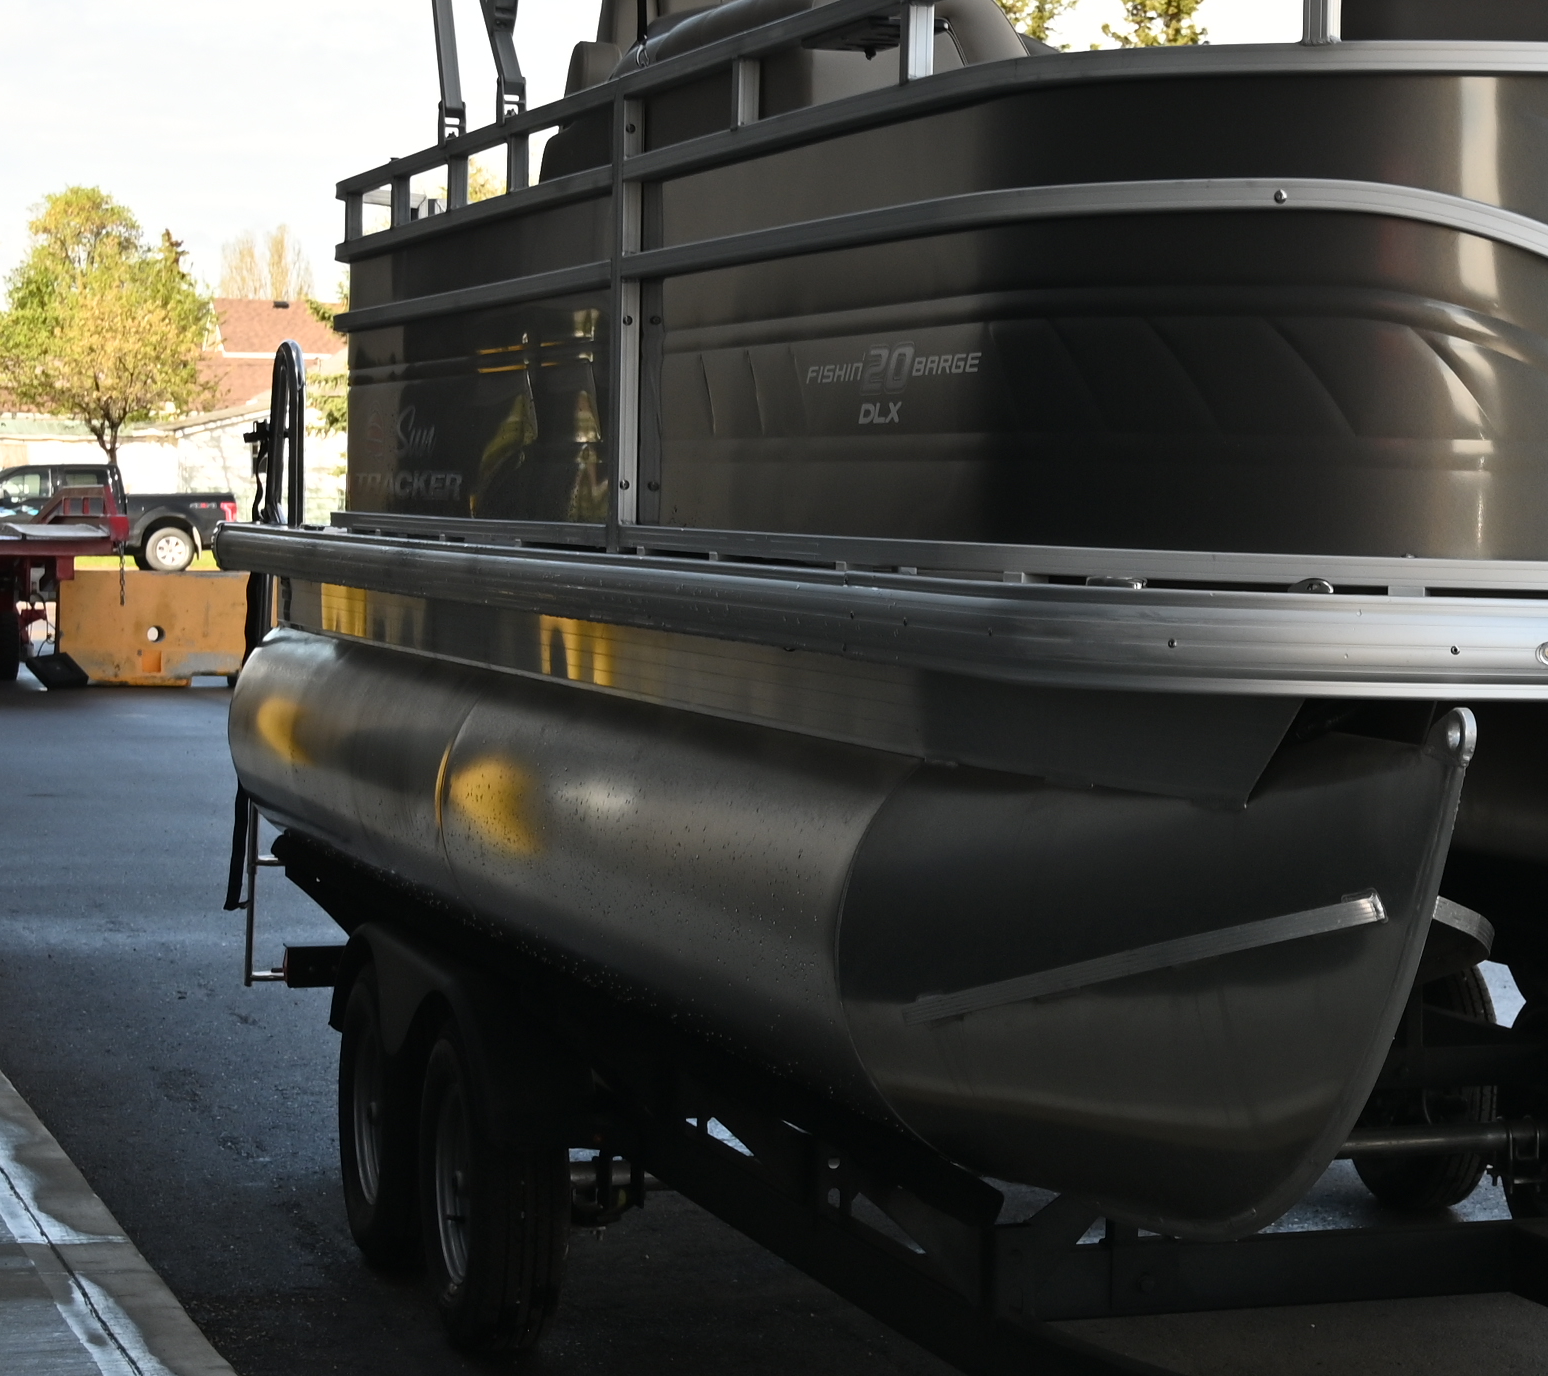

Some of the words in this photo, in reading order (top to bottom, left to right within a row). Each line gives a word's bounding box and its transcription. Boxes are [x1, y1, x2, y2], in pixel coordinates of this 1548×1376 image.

[860, 341, 915, 396] 20
[912, 352, 982, 377] BARGE
[858, 401, 902, 425] DLX
[356, 471, 462, 501] TRACKER
